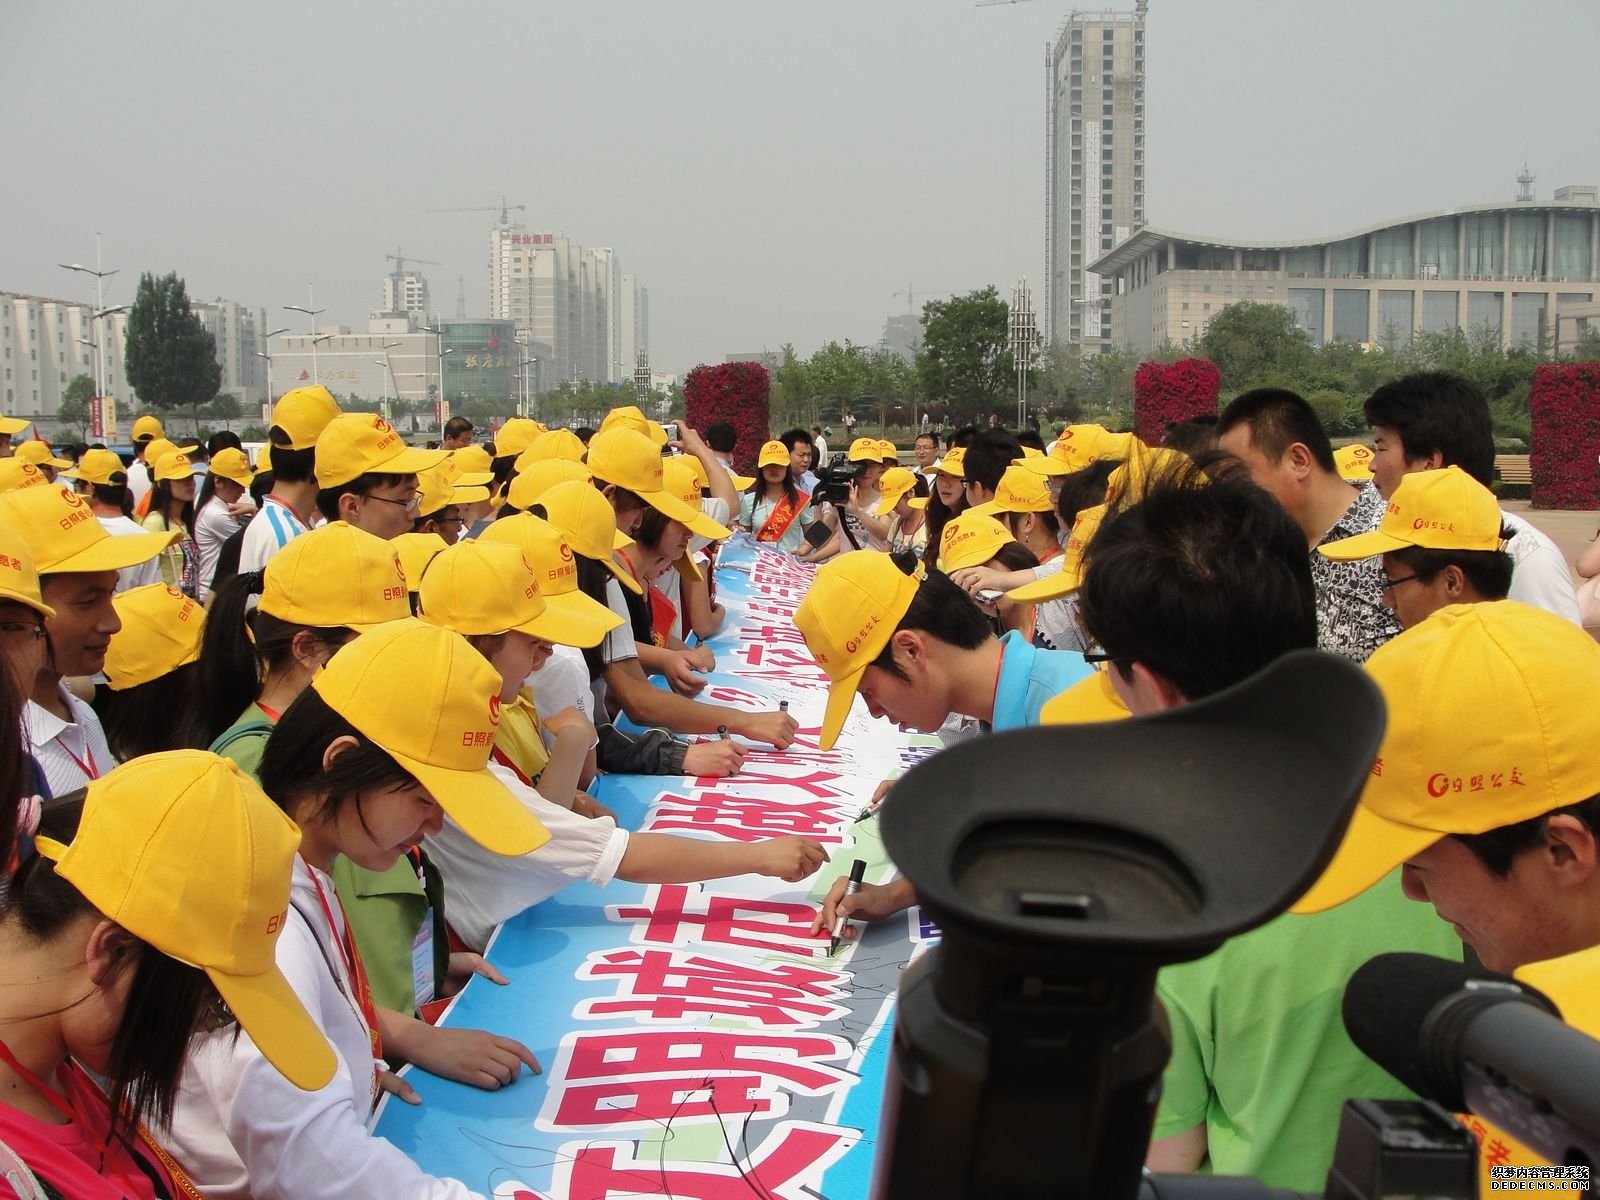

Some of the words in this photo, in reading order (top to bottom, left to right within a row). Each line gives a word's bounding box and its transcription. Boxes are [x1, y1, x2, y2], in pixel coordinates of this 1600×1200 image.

[511, 234, 553, 244] 兴业集团
[1452, 766, 1526, 793] 日照公交
